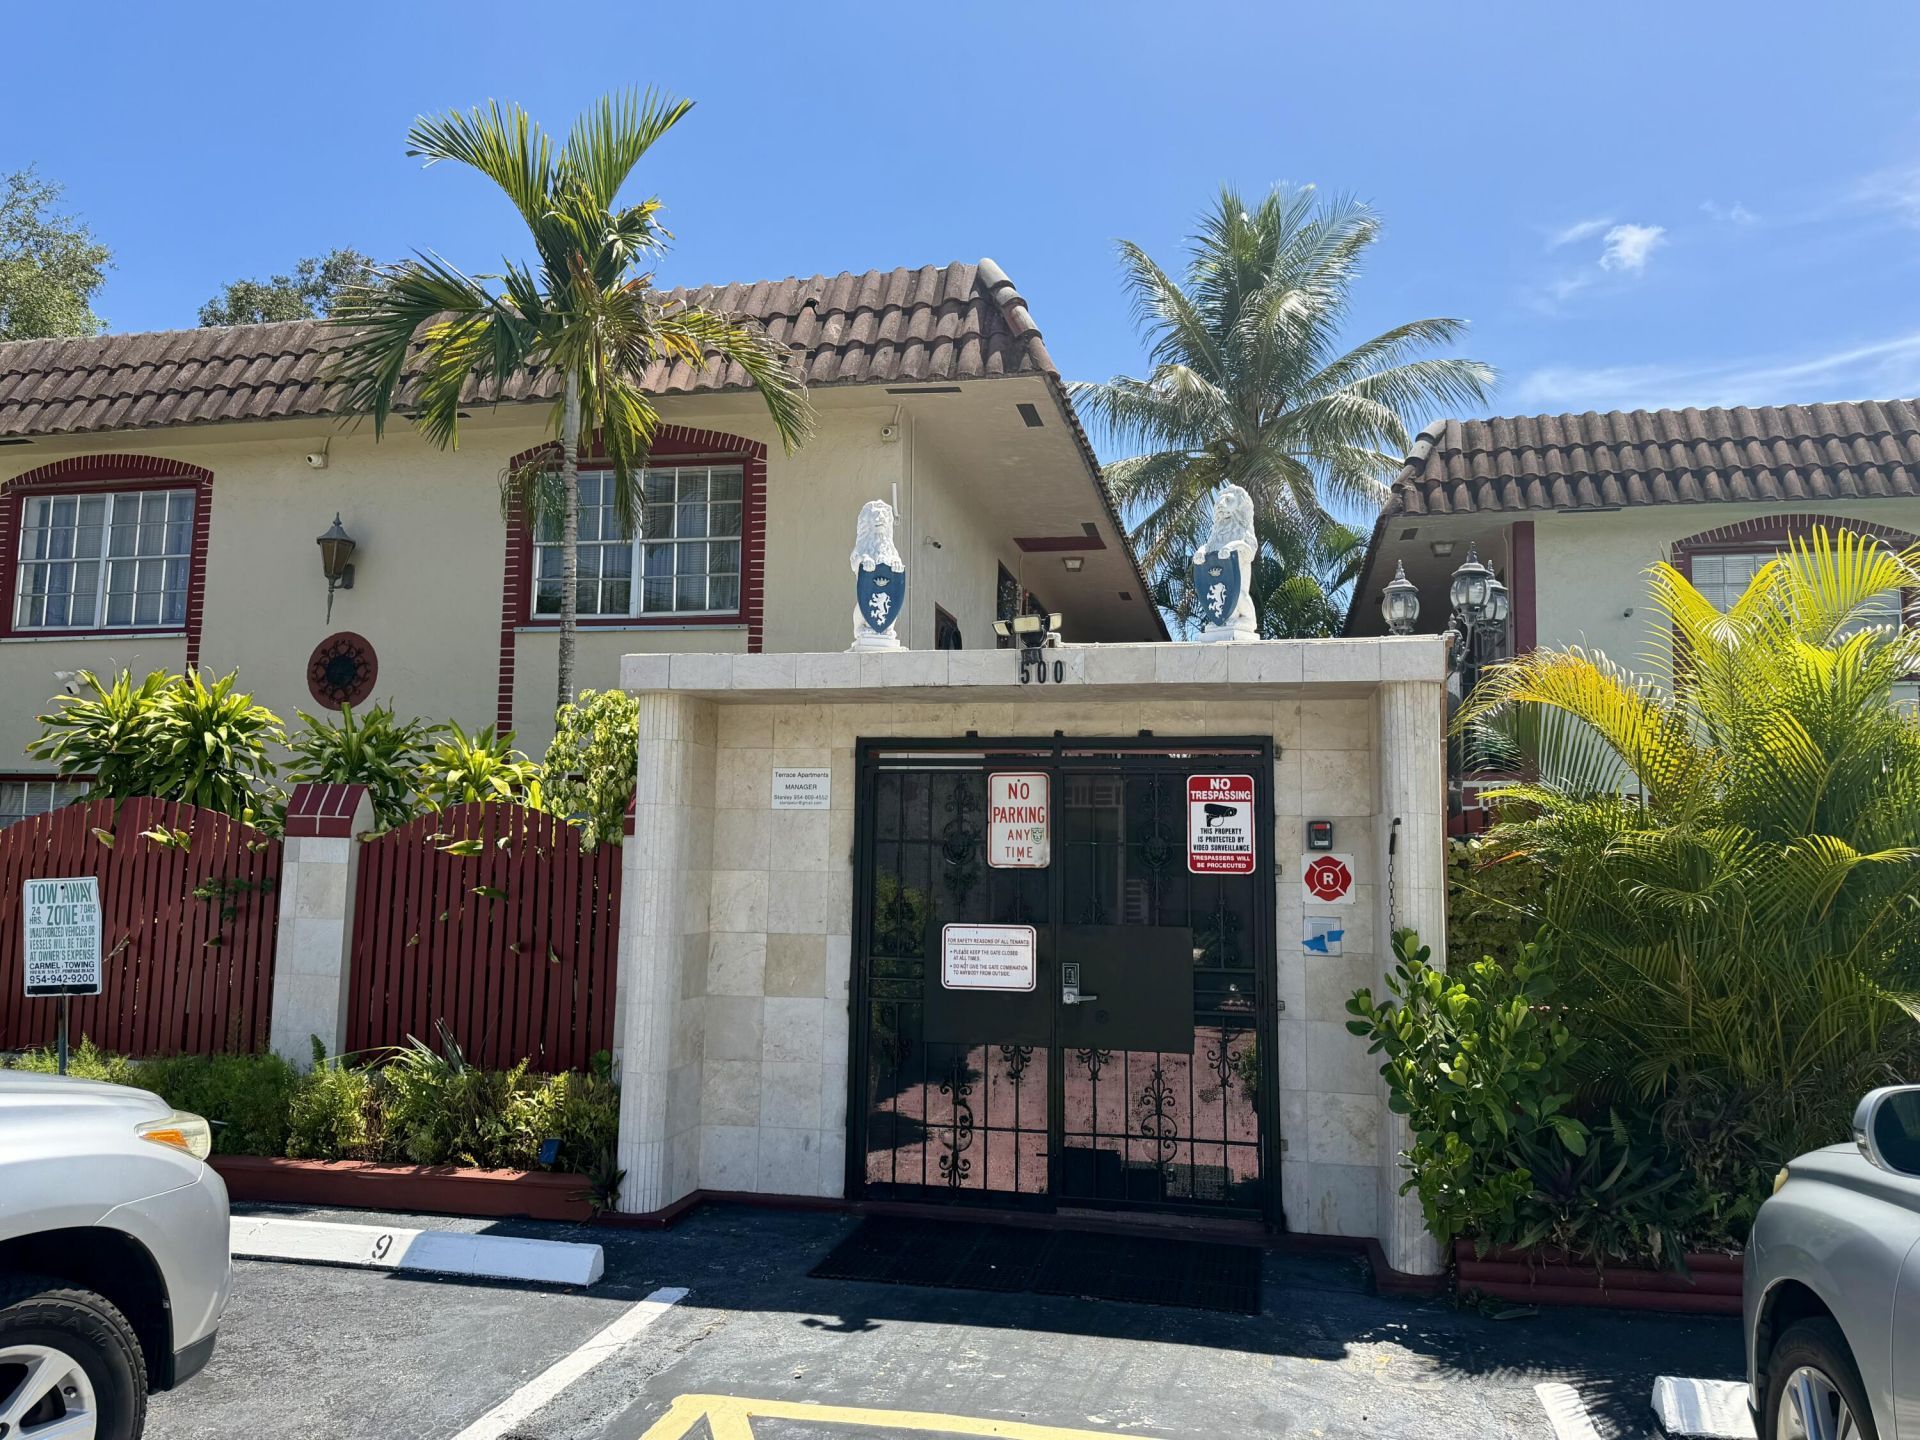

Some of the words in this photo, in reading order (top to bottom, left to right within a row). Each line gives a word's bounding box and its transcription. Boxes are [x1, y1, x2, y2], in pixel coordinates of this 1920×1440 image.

[1021, 660, 1063, 684] 500
[1210, 778, 1231, 790] NO
[1008, 783, 1030, 800] NO
[1190, 791, 1251, 800] TRESPASSING
[993, 807, 1045, 823] PARKING
[1007, 829, 1030, 841] ANY
[1005, 846, 1033, 858] TIME
[1323, 872, 1334, 885] R
[30, 884, 57, 904] TOW
[62, 882, 92, 903] AWAY
[29, 917, 43, 925] HRS.
[32, 907, 40, 916] 24
[47, 905, 78, 926] ZONE
[80, 905, 83, 914] 7
[84, 904, 96, 913] DAYS
[30, 927, 64, 938] UNAUTHORIZED
[65, 926, 87, 937] VEHICLES
[88, 925, 95, 936] OR
[30, 939, 51, 950] VESSELS
[54, 939, 66, 949] WILL
[68, 938, 74, 949] BE
[76, 937, 94, 948] TOWED
[30, 951, 37, 962] AT
[39, 950, 66, 961] OWNER'S
[67, 949, 95, 960] EXPENSE
[30, 974, 94, 984] 954-942-9200
[372, 1234, 393, 1259] 9
